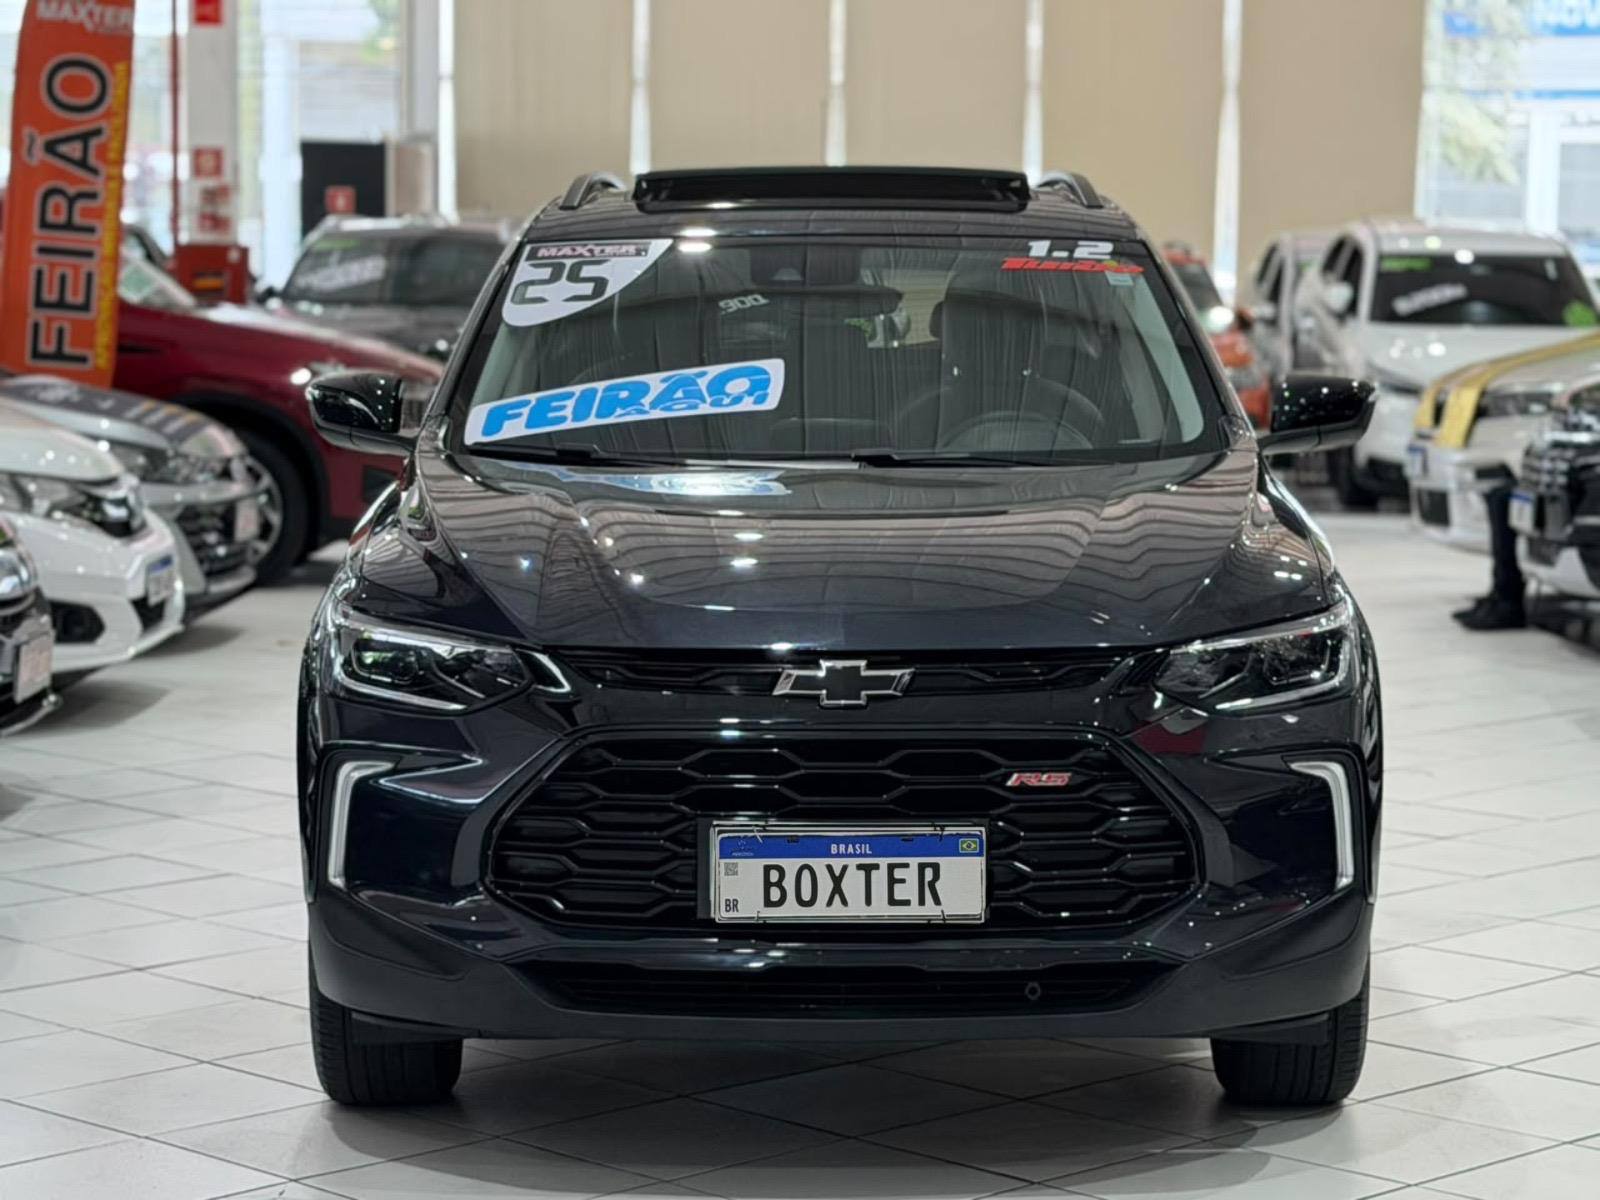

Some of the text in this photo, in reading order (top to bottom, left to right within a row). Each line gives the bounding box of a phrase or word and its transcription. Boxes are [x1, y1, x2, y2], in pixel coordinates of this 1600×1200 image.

[25, 57, 109, 366] FEIRÃO
[537, 244, 639, 257] MAXTER
[1027, 240, 1114, 259] 1.2
[510, 259, 612, 306] 25
[481, 364, 771, 437] FEIRÃO
[1006, 772, 1072, 786] RS
[830, 843, 872, 855] BRASIL
[762, 862, 942, 908] BOXTER
[724, 898, 739, 913] BR
